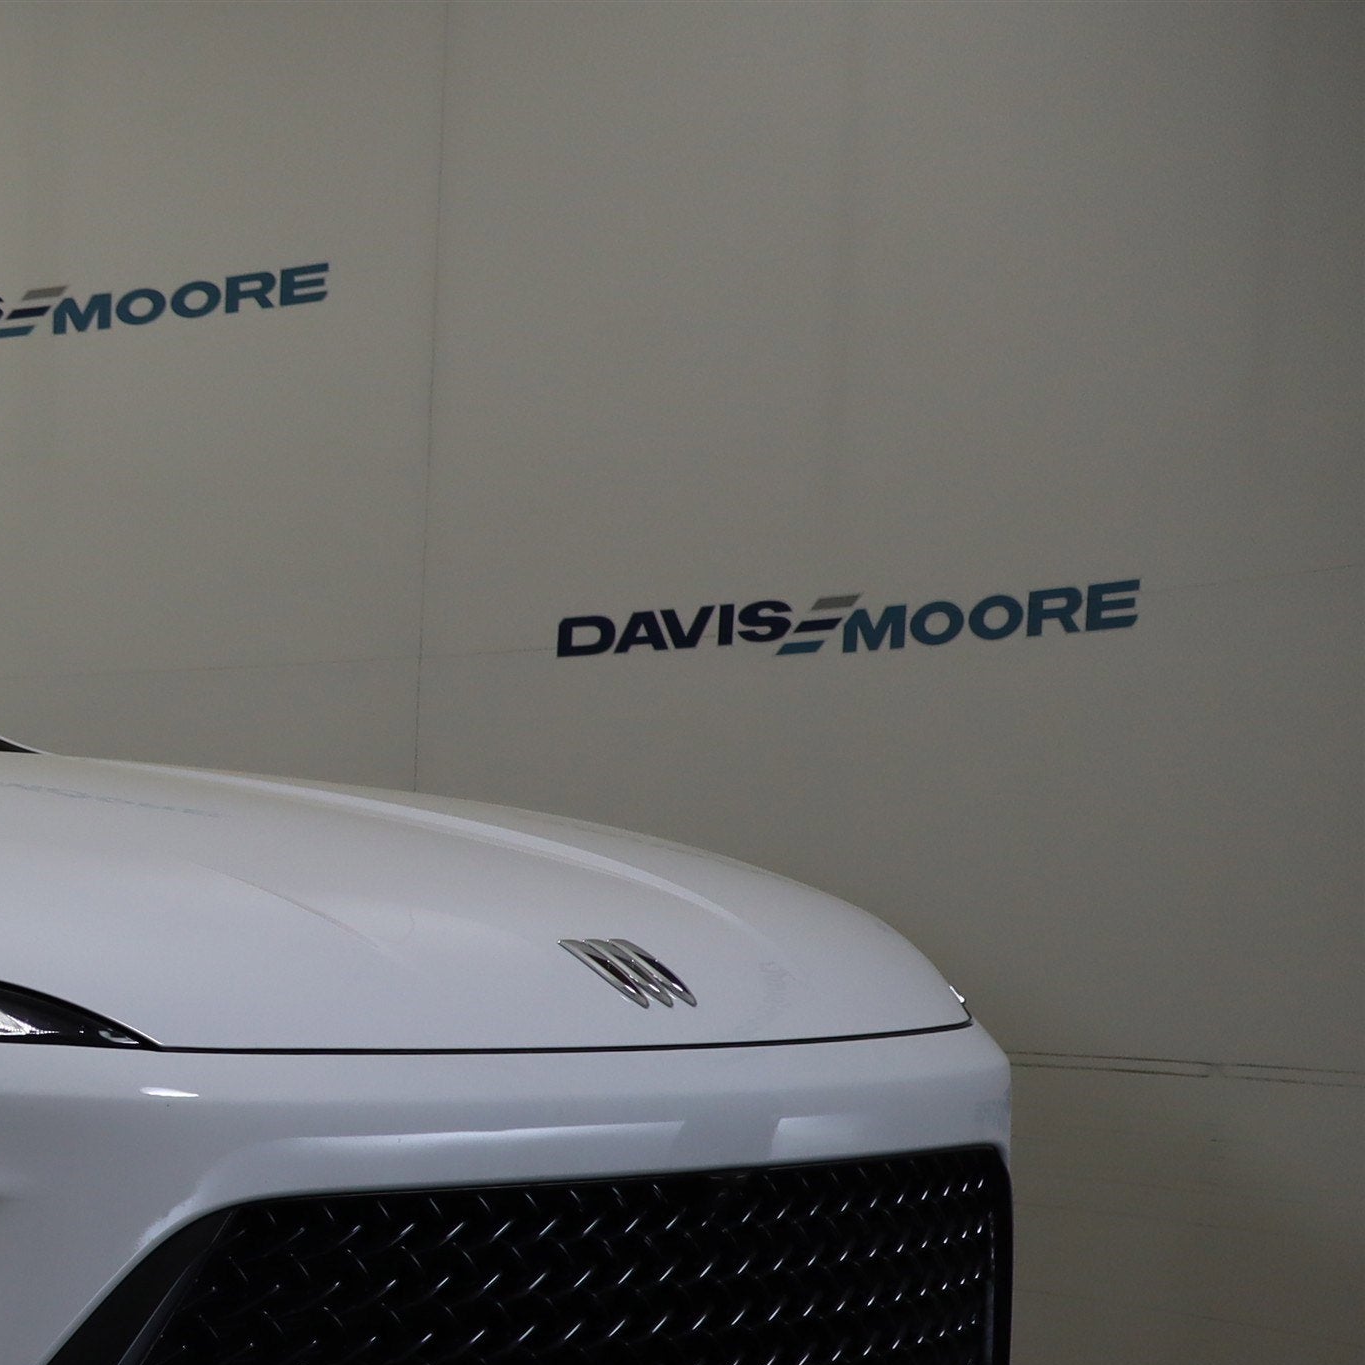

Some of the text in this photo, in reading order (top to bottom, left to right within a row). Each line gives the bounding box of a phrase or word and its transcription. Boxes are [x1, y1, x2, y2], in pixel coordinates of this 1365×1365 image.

[53, 263, 329, 335] MOORE
[557, 579, 1141, 658] DAVIS MOORE
